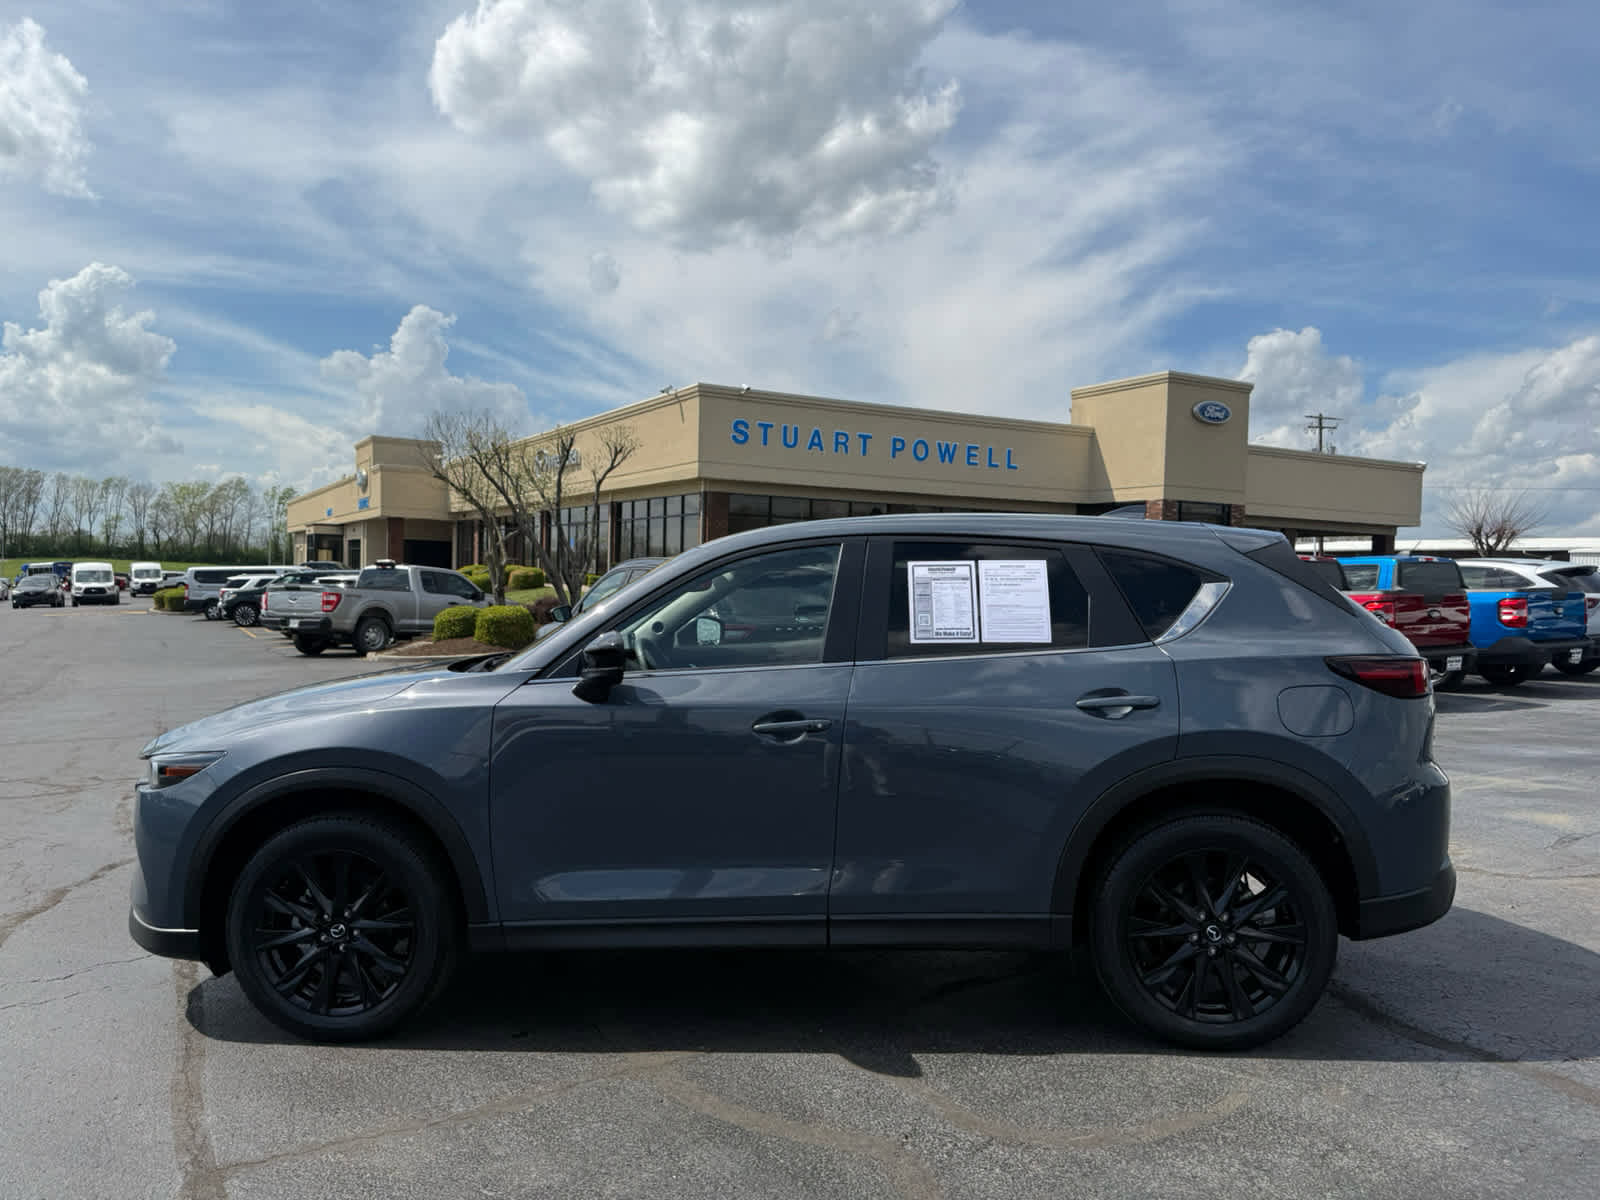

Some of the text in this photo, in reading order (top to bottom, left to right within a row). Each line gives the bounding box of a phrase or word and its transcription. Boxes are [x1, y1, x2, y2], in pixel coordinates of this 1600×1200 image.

[1204, 405, 1225, 419] Ford
[731, 418, 1019, 470] STUART POWELL
